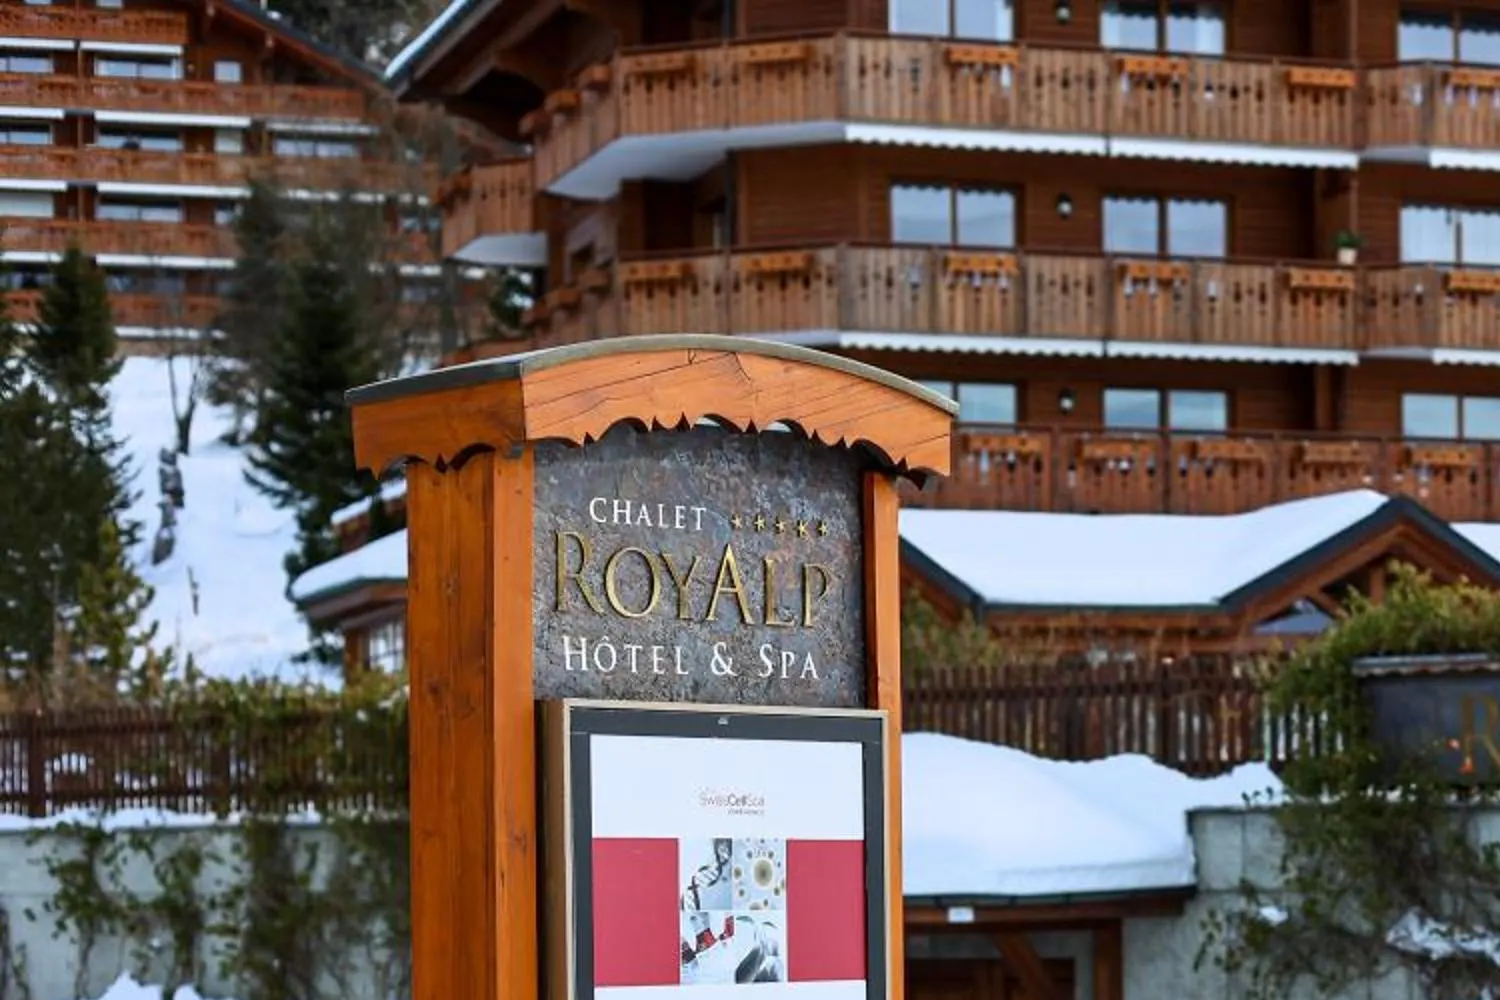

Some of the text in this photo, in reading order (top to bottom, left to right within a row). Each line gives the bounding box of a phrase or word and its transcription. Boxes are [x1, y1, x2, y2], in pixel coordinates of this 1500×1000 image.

[589, 497, 707, 531] CHALET
[555, 530, 832, 628] ROYALP
[562, 634, 820, 680] HÔTEL & SPA
